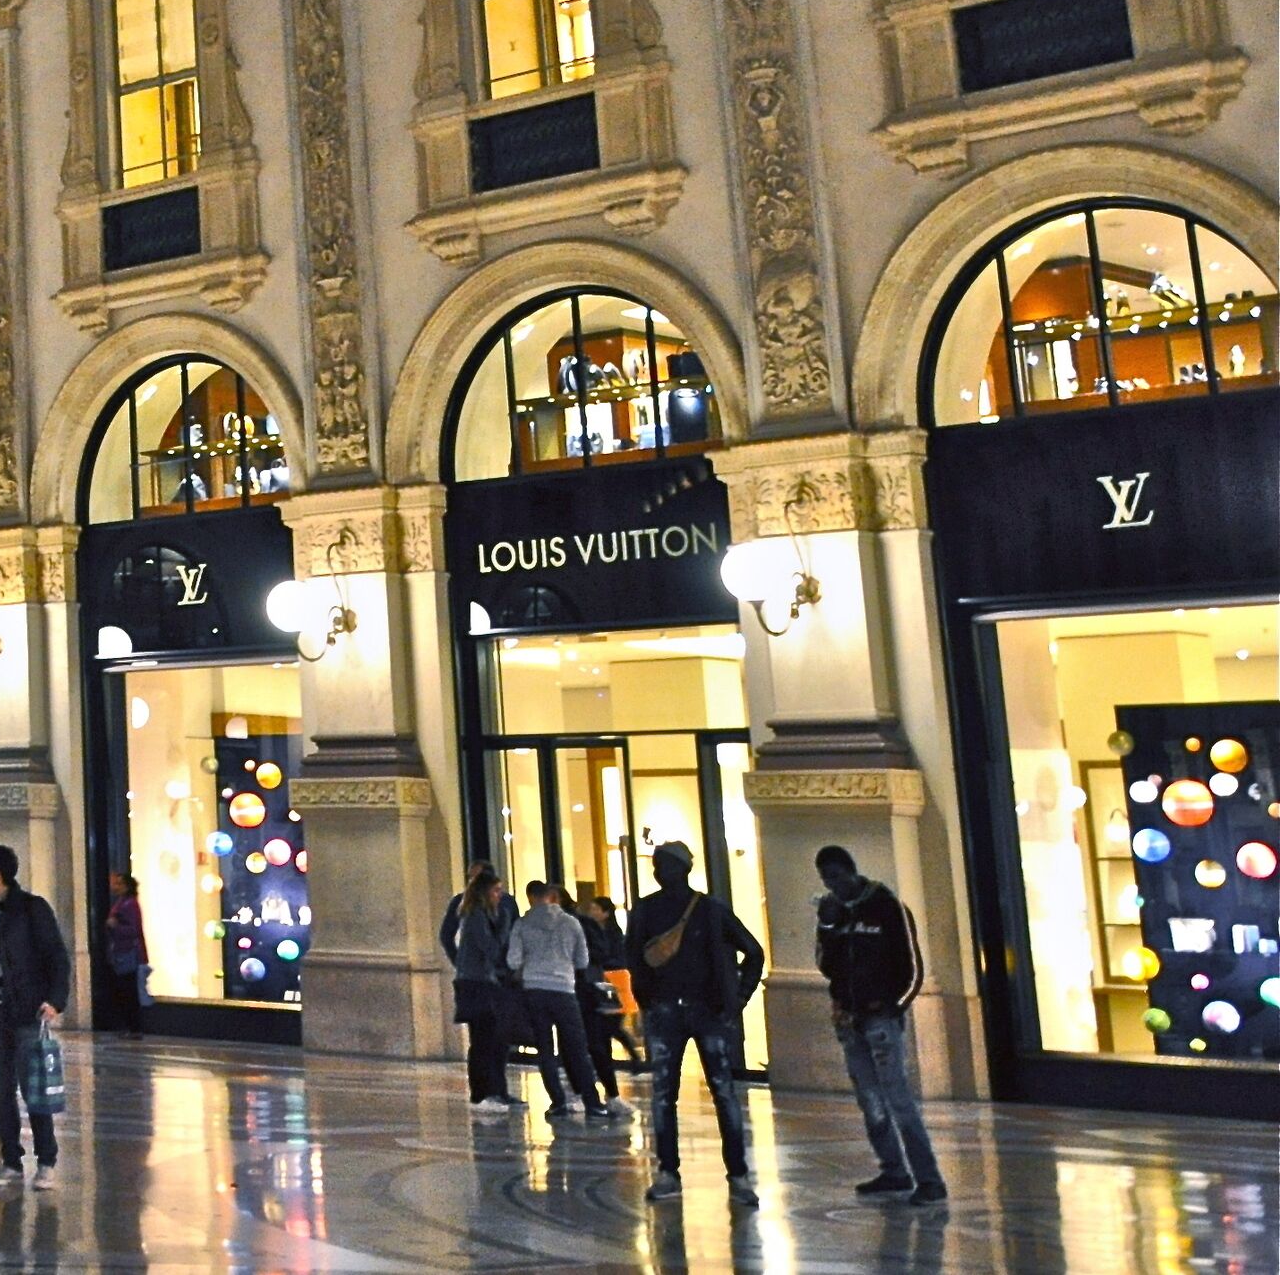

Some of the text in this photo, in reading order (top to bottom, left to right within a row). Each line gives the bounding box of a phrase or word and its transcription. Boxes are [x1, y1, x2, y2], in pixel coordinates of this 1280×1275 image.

[1095, 471, 1155, 530] LV
[477, 521, 719, 574] LOUIS VUITTON
[175, 563, 209, 606] LV
